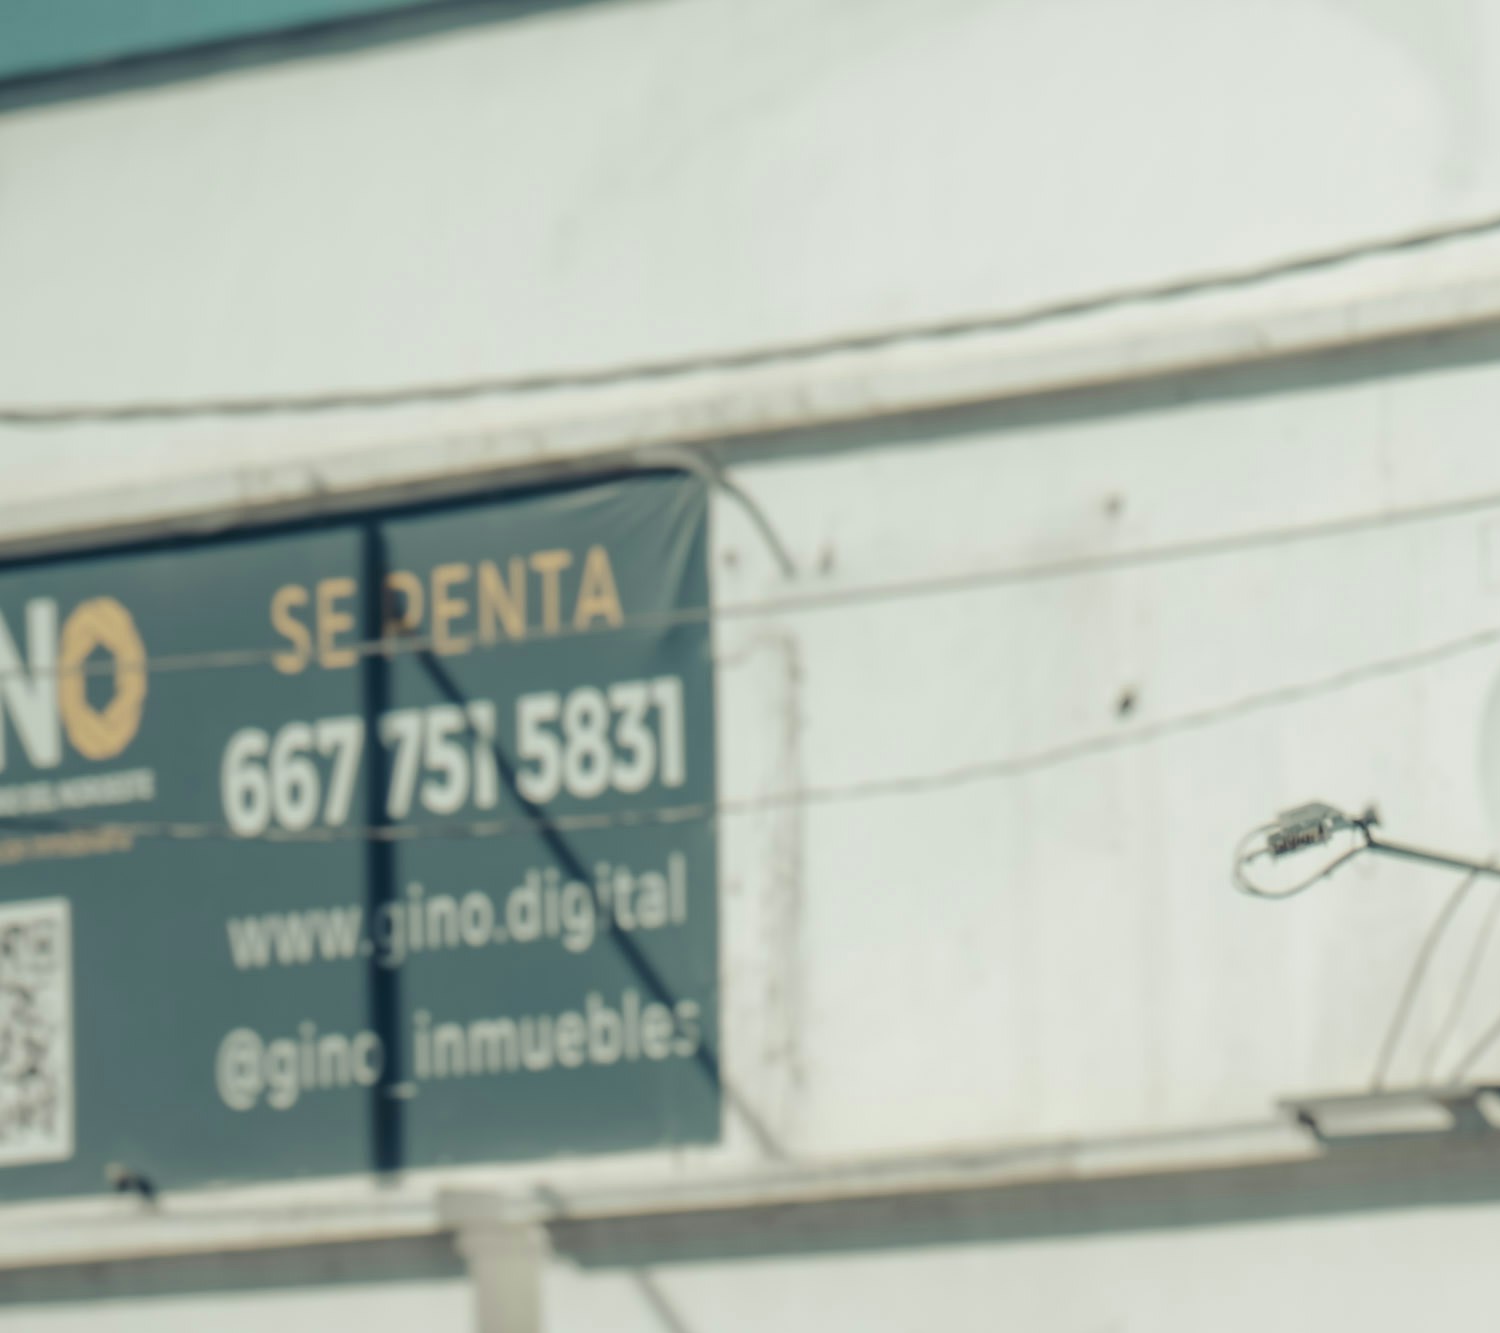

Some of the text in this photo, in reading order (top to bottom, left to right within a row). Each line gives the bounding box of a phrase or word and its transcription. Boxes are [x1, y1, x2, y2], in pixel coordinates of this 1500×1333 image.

[270, 577, 359, 675] SE
[220, 675, 686, 837] 667 751 5831
[227, 850, 688, 970] www.gino.digital
[215, 989, 701, 1111] @gino_inmuebles
